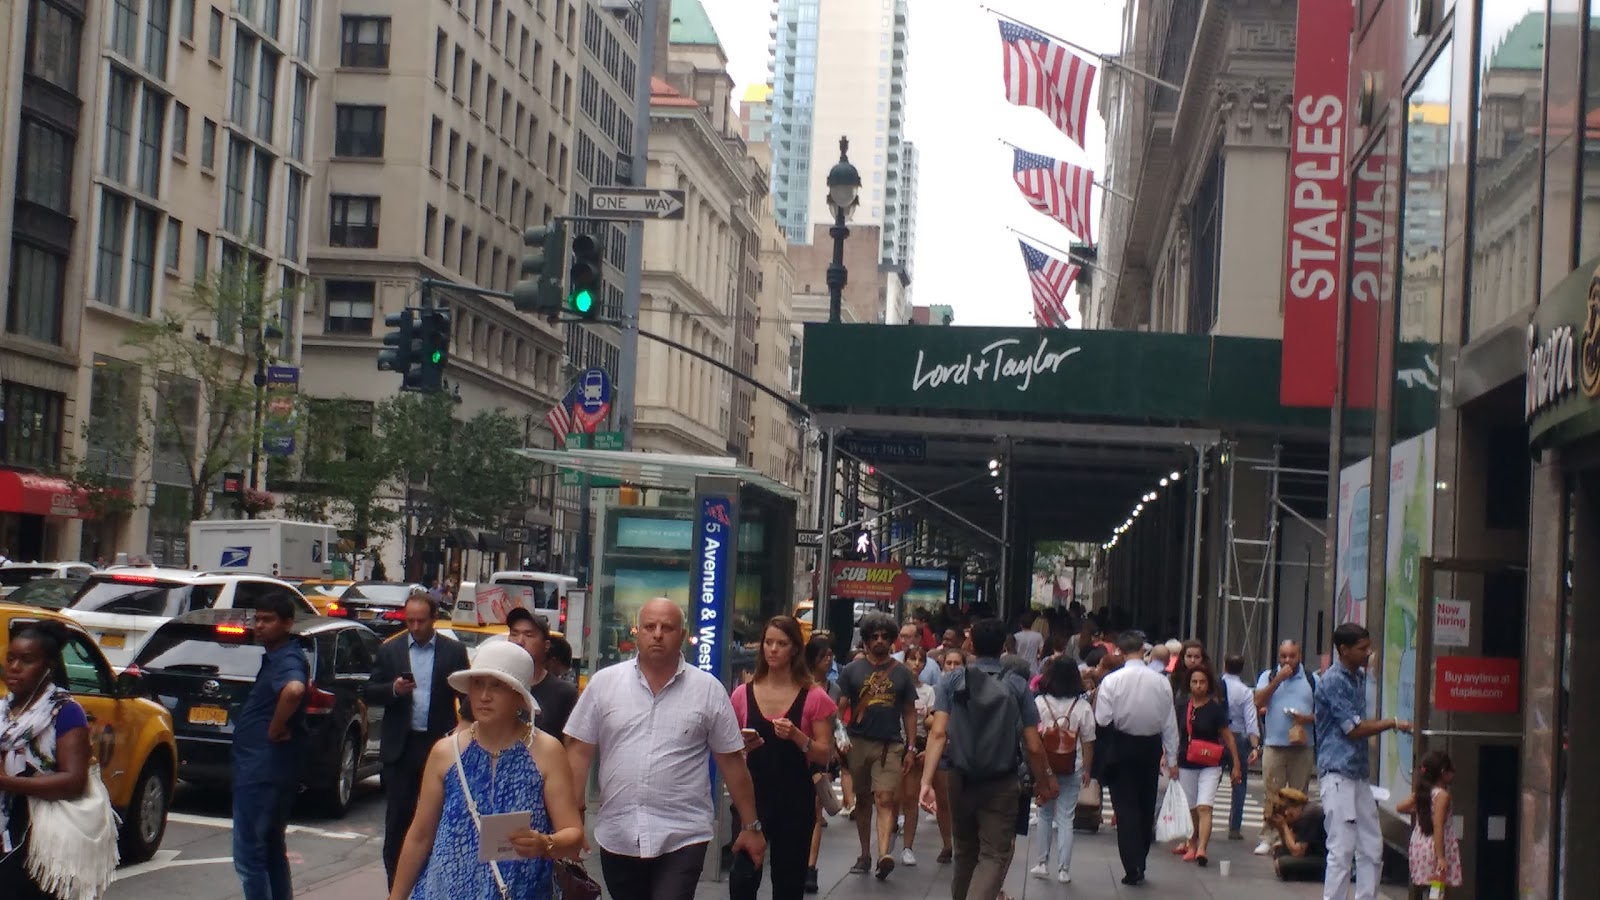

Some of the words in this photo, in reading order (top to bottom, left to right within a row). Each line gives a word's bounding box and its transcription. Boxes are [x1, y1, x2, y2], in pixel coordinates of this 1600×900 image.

[597, 196, 627, 209] ONE
[644, 198, 674, 211] WAY
[1290, 95, 1342, 300] STAPLES
[912, 350, 971, 391] Lord
[981, 337, 1081, 391] Taylor
[706, 522, 721, 533] 5
[702, 537, 720, 604] Avenue
[837, 567, 902, 583] SUBWAY
[701, 610, 716, 621] &
[1437, 603, 1460, 615] Now
[1437, 616, 1466, 628] hiring
[698, 625, 716, 672] West
[1444, 671, 1462, 683] Buy
[1463, 673, 1499, 685] anytime
[1501, 674, 1510, 684] at
[1450, 687, 1503, 699] staples.com
